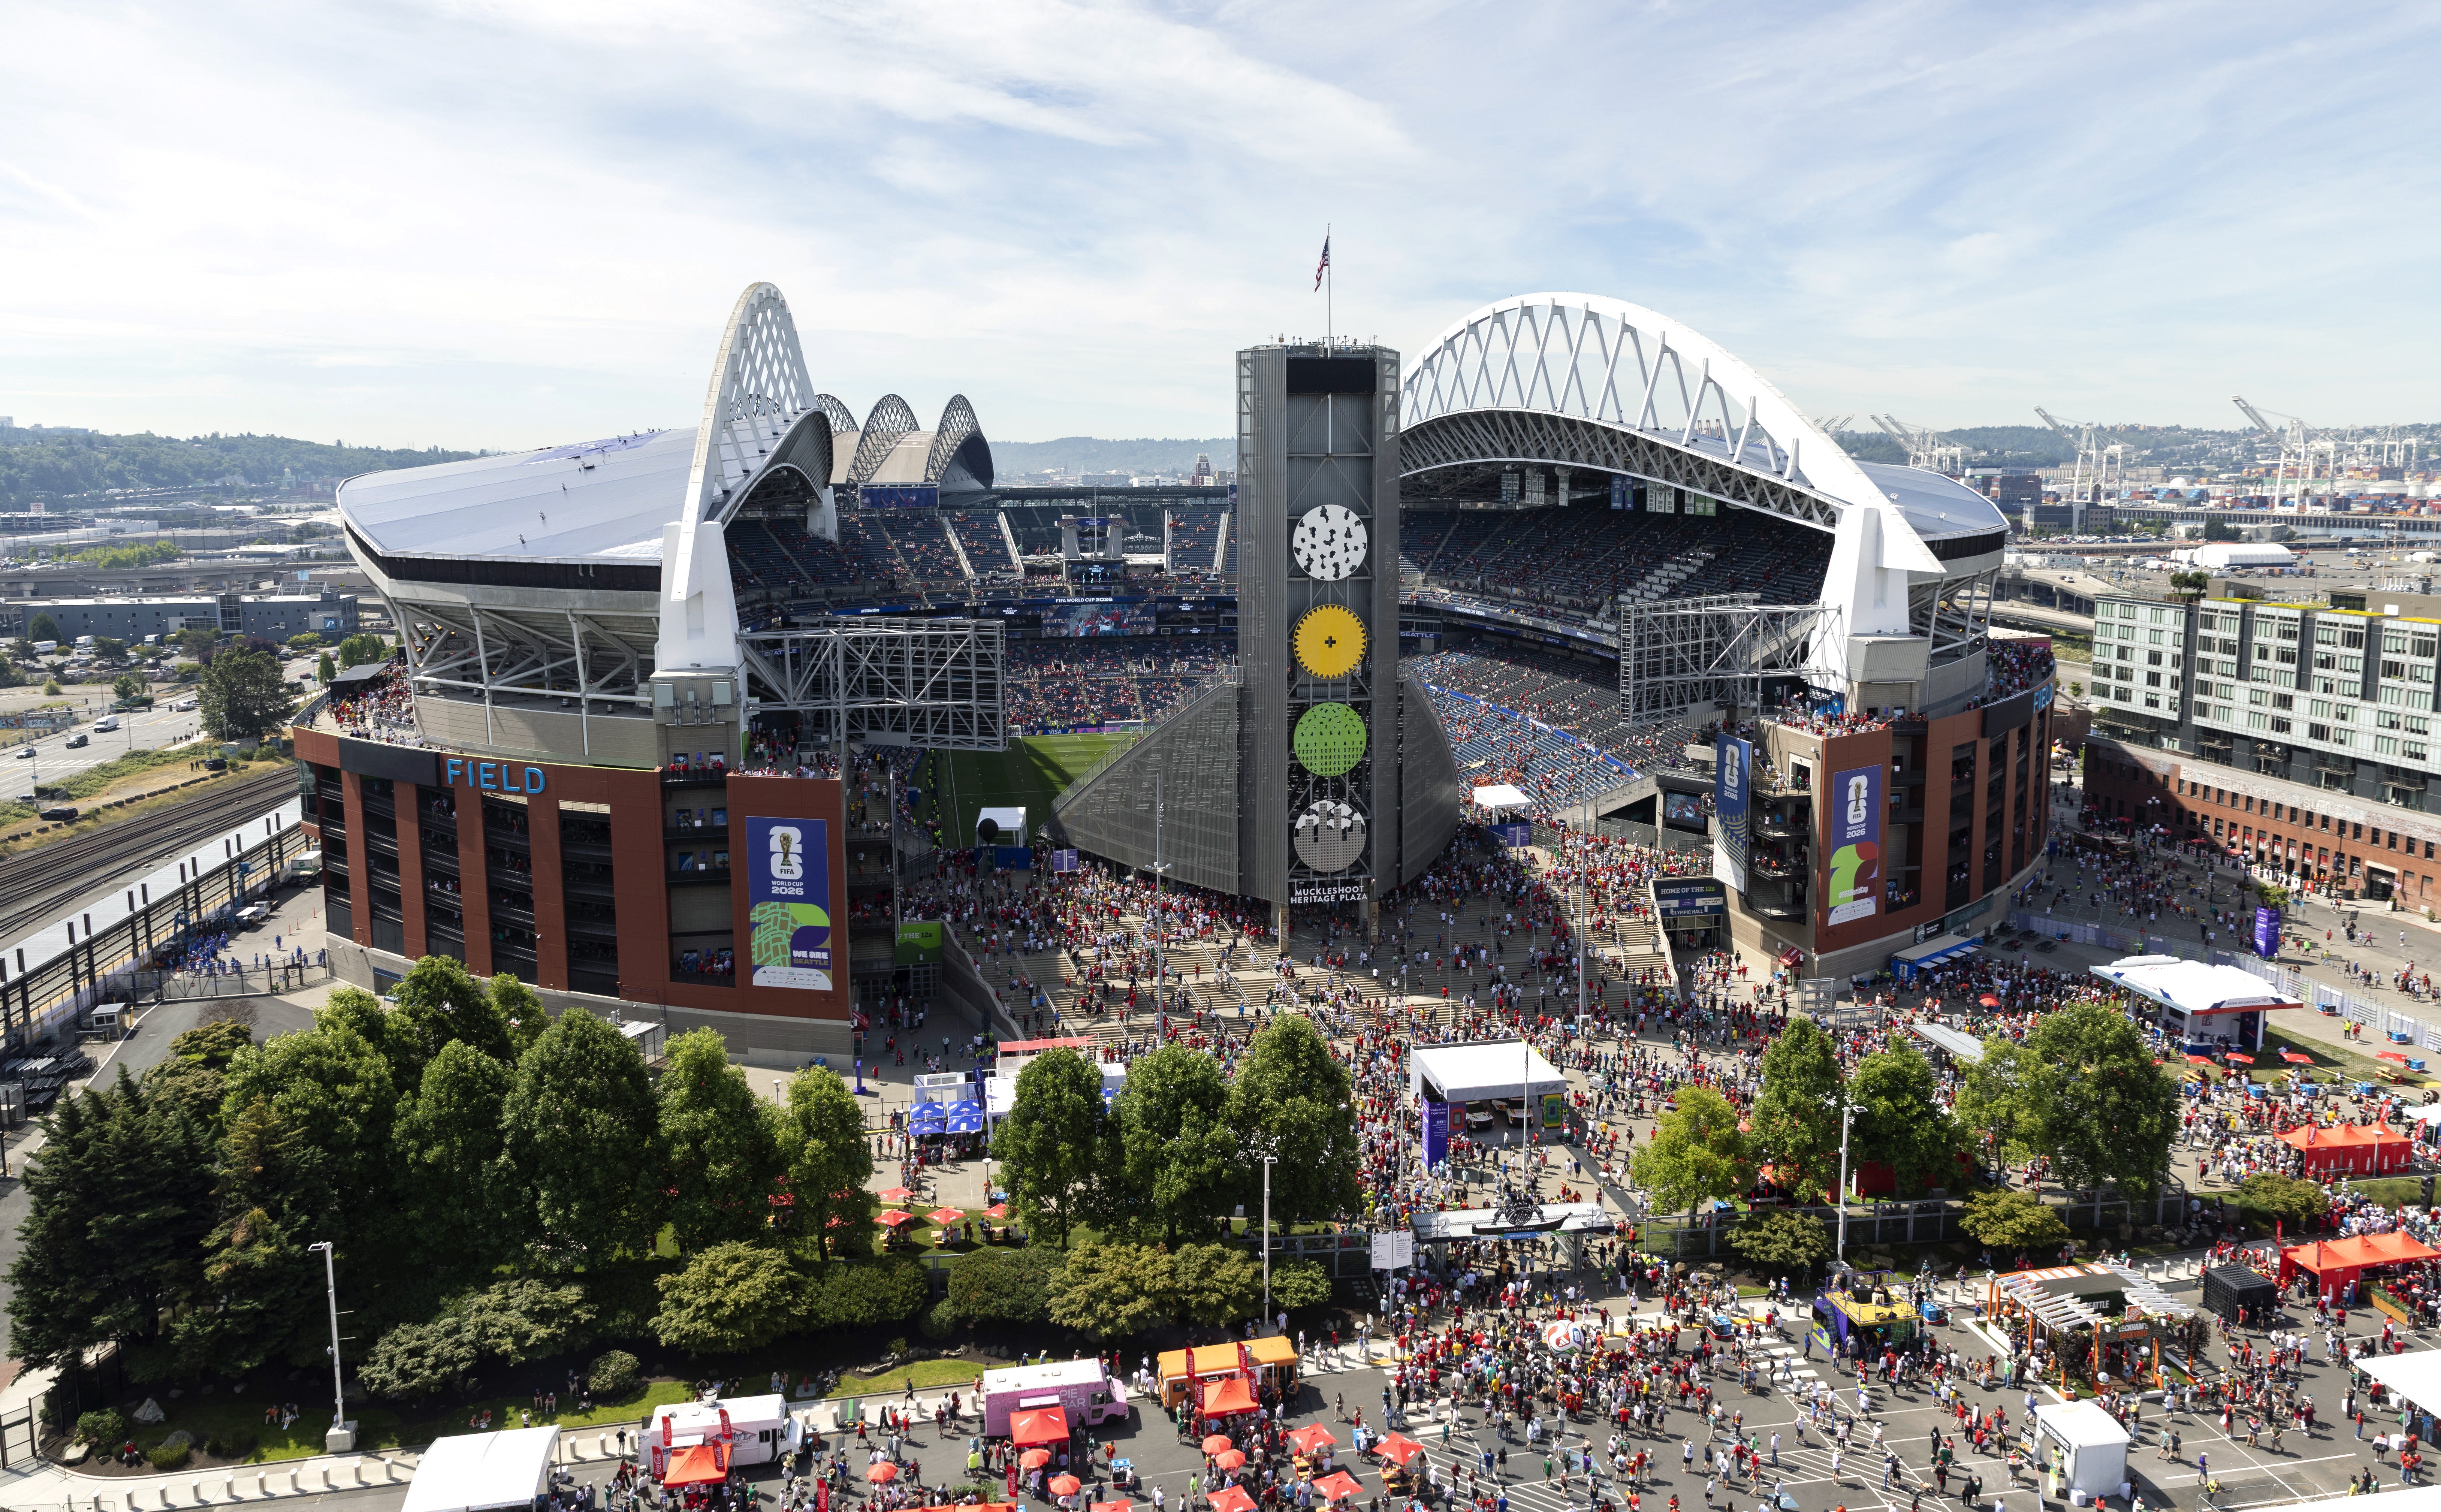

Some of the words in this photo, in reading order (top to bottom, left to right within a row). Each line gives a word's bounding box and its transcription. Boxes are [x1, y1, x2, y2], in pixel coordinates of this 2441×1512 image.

[2034, 682, 2053, 713] FIELD
[447, 759, 546, 794] FIELD
[1724, 790, 1738, 800] 2026
[1846, 829, 1866, 839] 2026
[772, 886, 804, 895] 2026
[1295, 885, 1364, 896] MUCKLESHOOT
[1291, 894, 1335, 904] HERITAGE
[1340, 893, 1368, 901] PLAZA
[1593, 1208, 1605, 1227] 2
[1437, 1218, 1450, 1237] 2
[2086, 1300, 2110, 1309] SEATTLE
[1059, 1388, 1078, 1399] PIE
[1059, 1398, 1086, 1409] BAR
[722, 1415, 730, 1434] Coca-Cola
[713, 1446, 724, 1467] Coca-Cola
[1008, 1473, 1016, 1493] Coca-Cola
